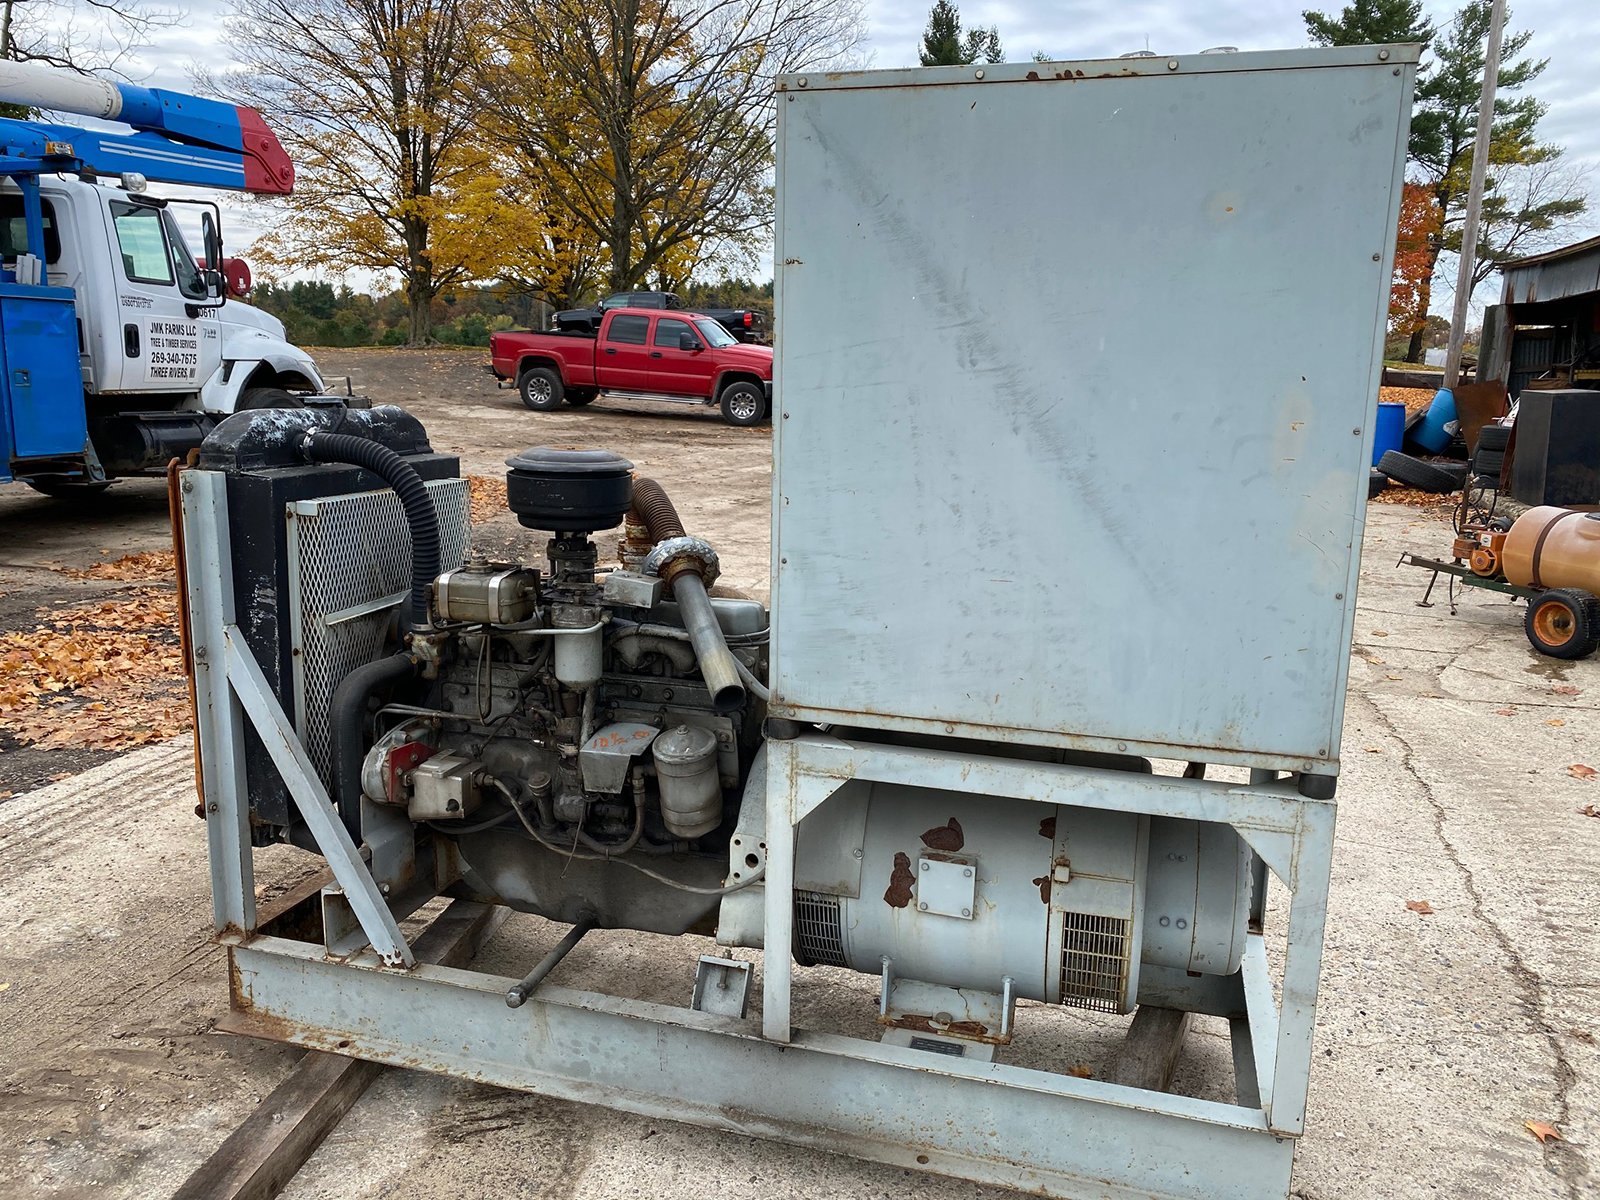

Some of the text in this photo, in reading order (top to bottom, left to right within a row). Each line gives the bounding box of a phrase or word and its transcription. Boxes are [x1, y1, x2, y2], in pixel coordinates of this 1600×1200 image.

[150, 322, 197, 337] JMK FARMS LLC
[150, 338, 161, 348] TREE
[165, 338, 179, 349] TIMBER
[180, 339, 197, 349] SERVICES
[151, 352, 197, 364] 269-340-7675
[150, 367, 168, 378] THREE
[169, 367, 188, 380] RIVERS,
